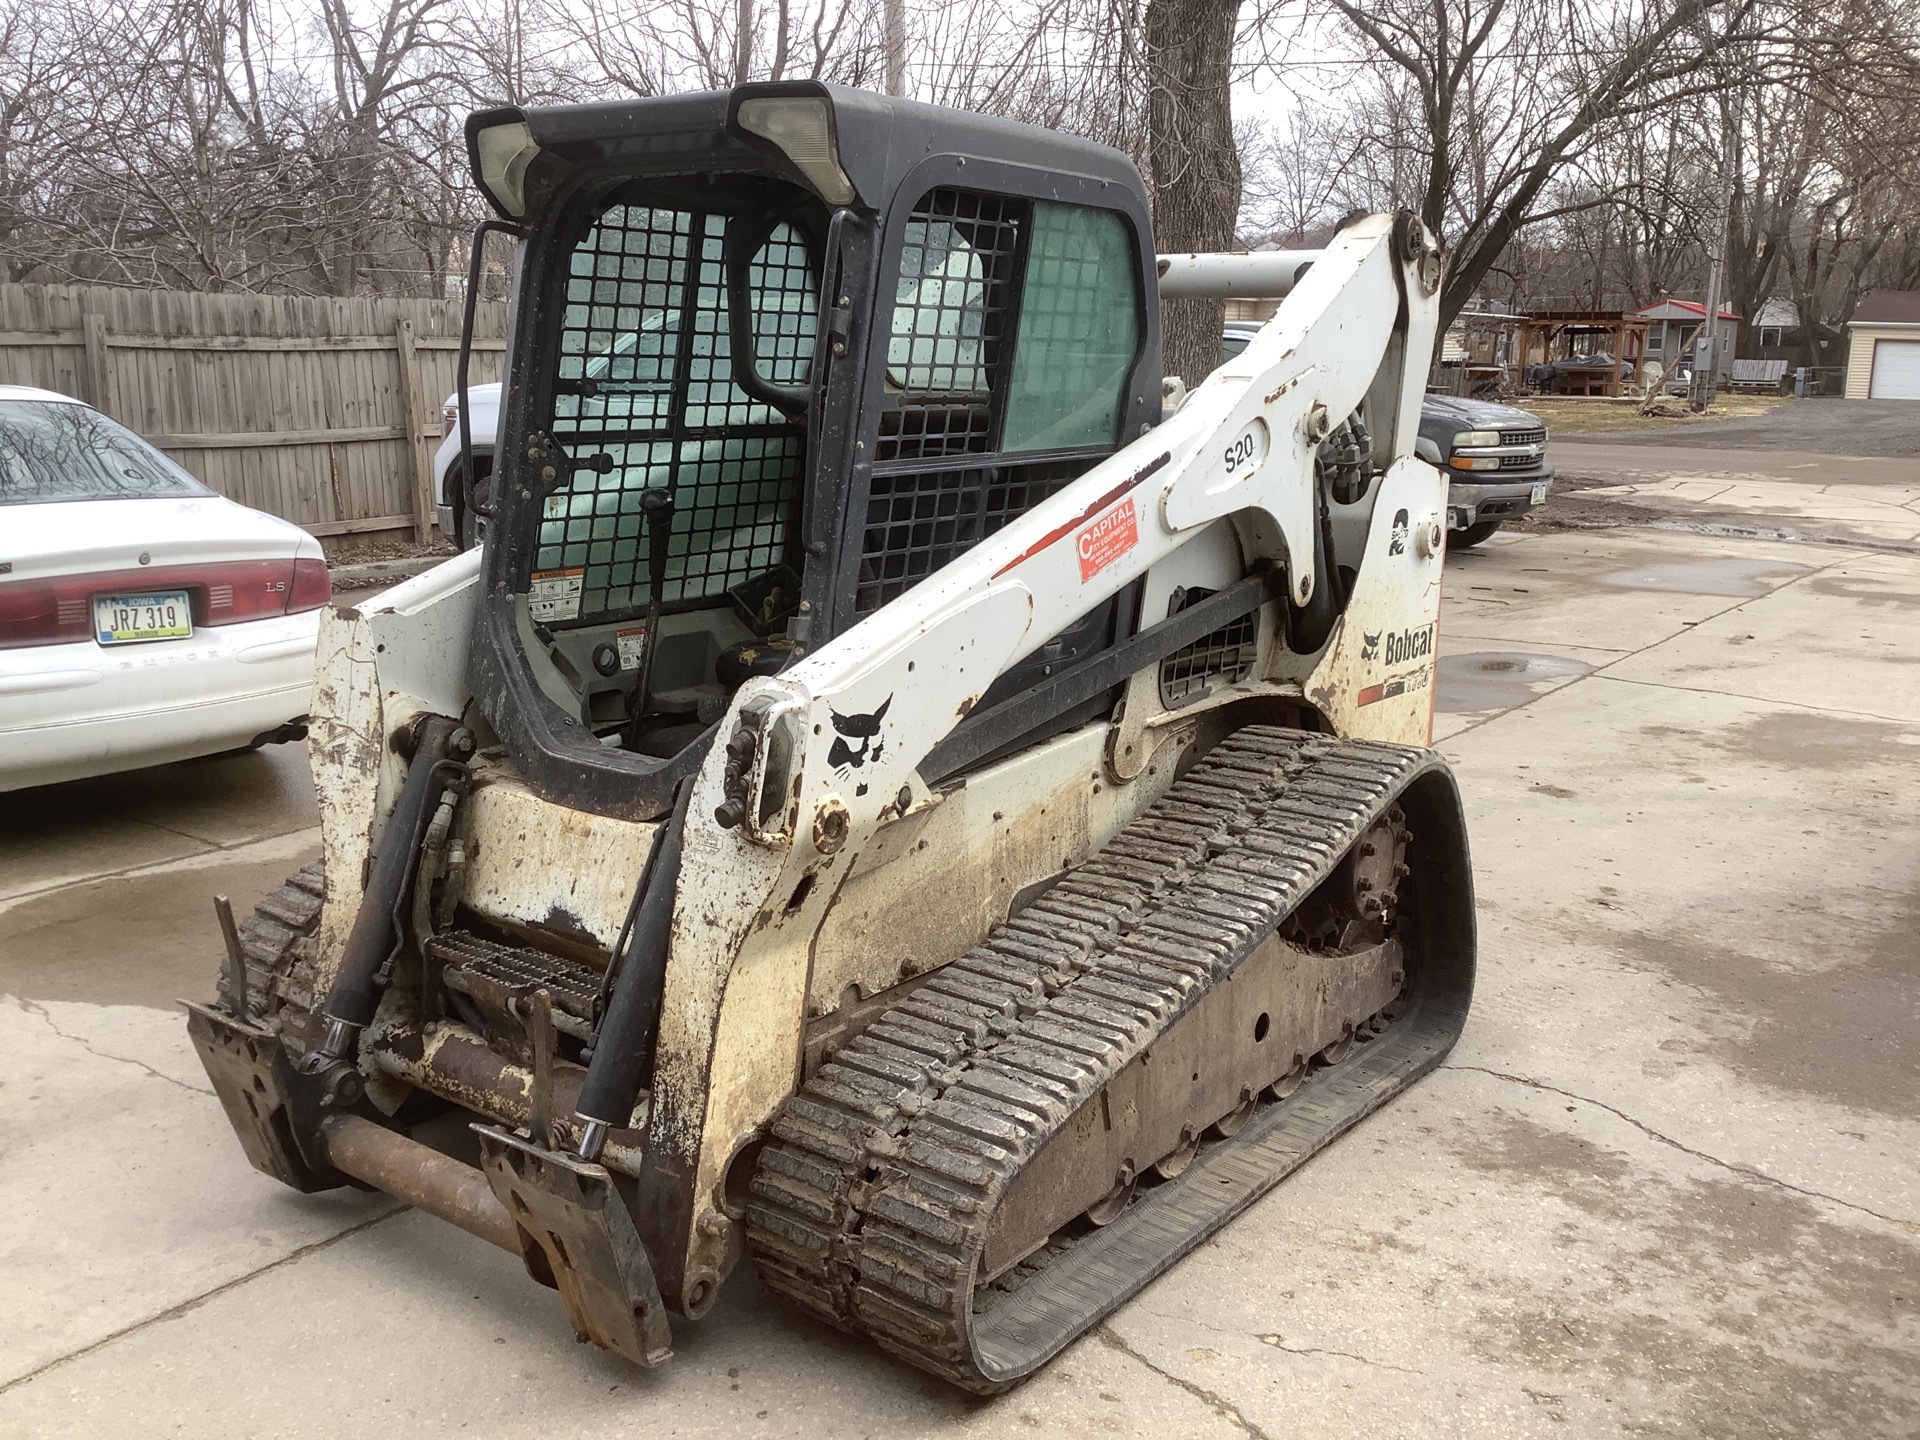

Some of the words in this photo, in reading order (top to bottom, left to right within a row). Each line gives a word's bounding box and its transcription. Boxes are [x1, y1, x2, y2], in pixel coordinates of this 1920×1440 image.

[1225, 433, 1253, 473] S20
[1079, 503, 1133, 559] CAPITAL
[128, 596, 156, 606] IOWA
[266, 582, 285, 592] LS
[111, 609, 140, 632] JRZ
[146, 606, 177, 629] 319
[1385, 623, 1433, 666] Bobcat
